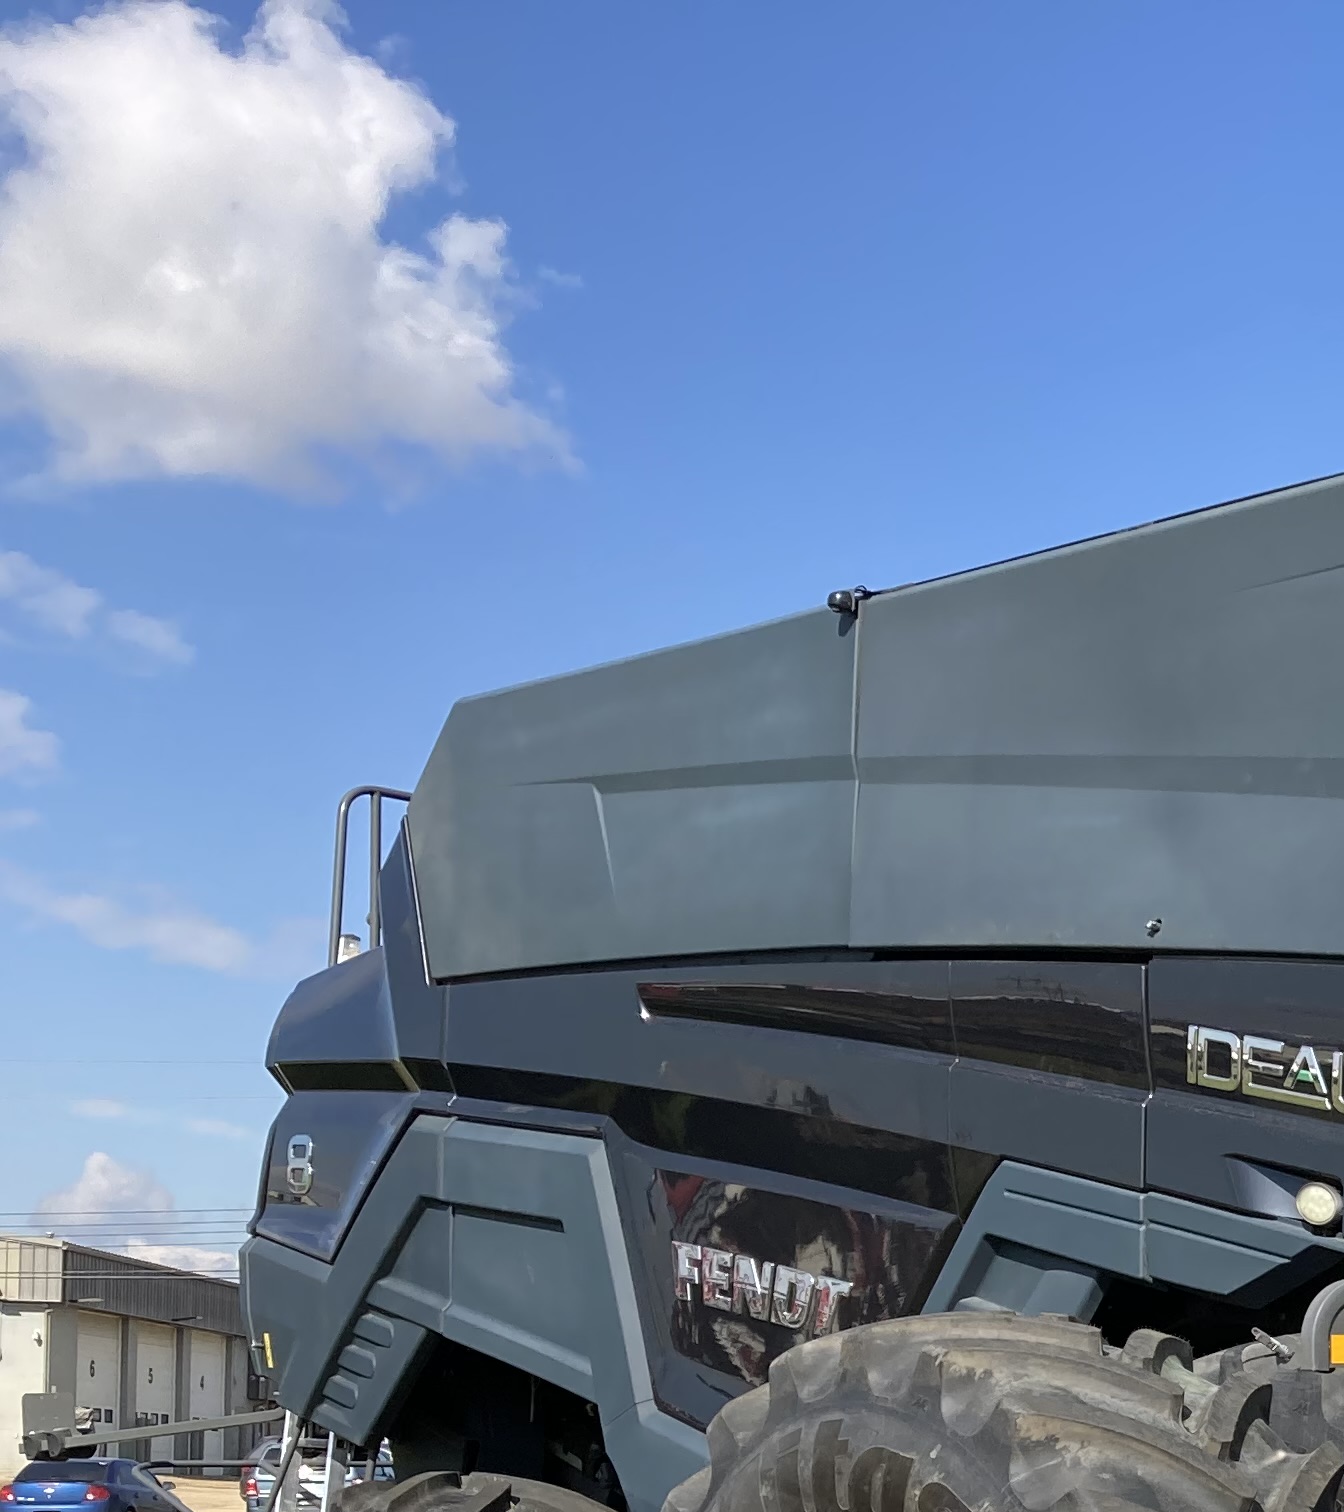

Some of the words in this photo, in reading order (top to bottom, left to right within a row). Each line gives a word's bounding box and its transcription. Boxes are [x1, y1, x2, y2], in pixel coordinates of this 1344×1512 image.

[285, 1133, 315, 1196] 8
[671, 1240, 857, 1338] FENDT
[88, 1358, 96, 1378] 6
[146, 1367, 154, 1385] 5
[199, 1374, 206, 1392] 4
